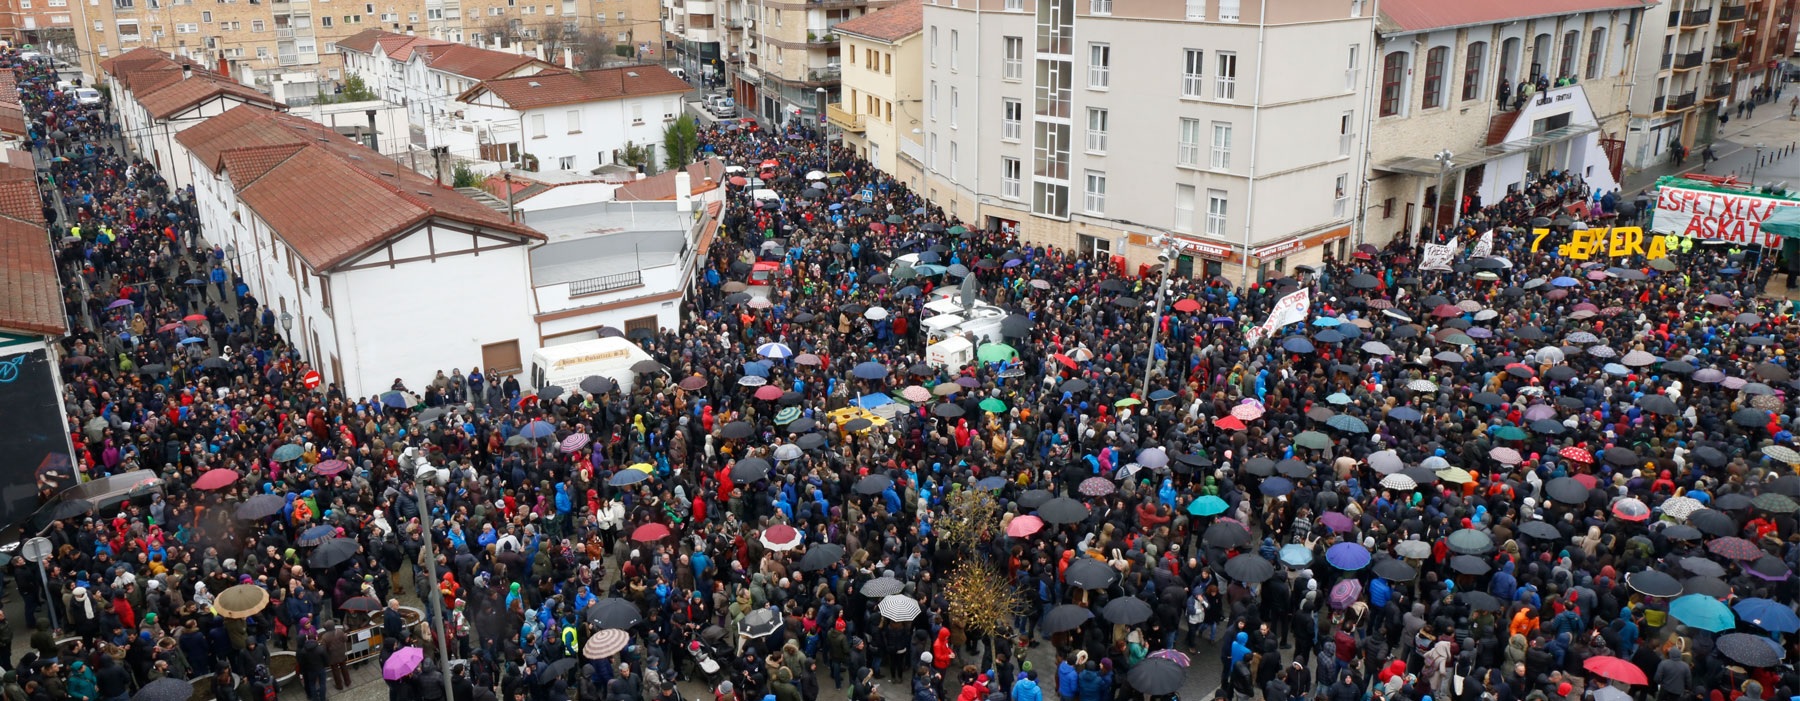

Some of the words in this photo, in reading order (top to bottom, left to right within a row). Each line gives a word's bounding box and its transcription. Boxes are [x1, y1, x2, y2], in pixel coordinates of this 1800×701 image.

[1657, 187, 1800, 222] ESPETXERA
[1530, 228, 1550, 253] 7
[1684, 215, 1781, 248] ASKATU
